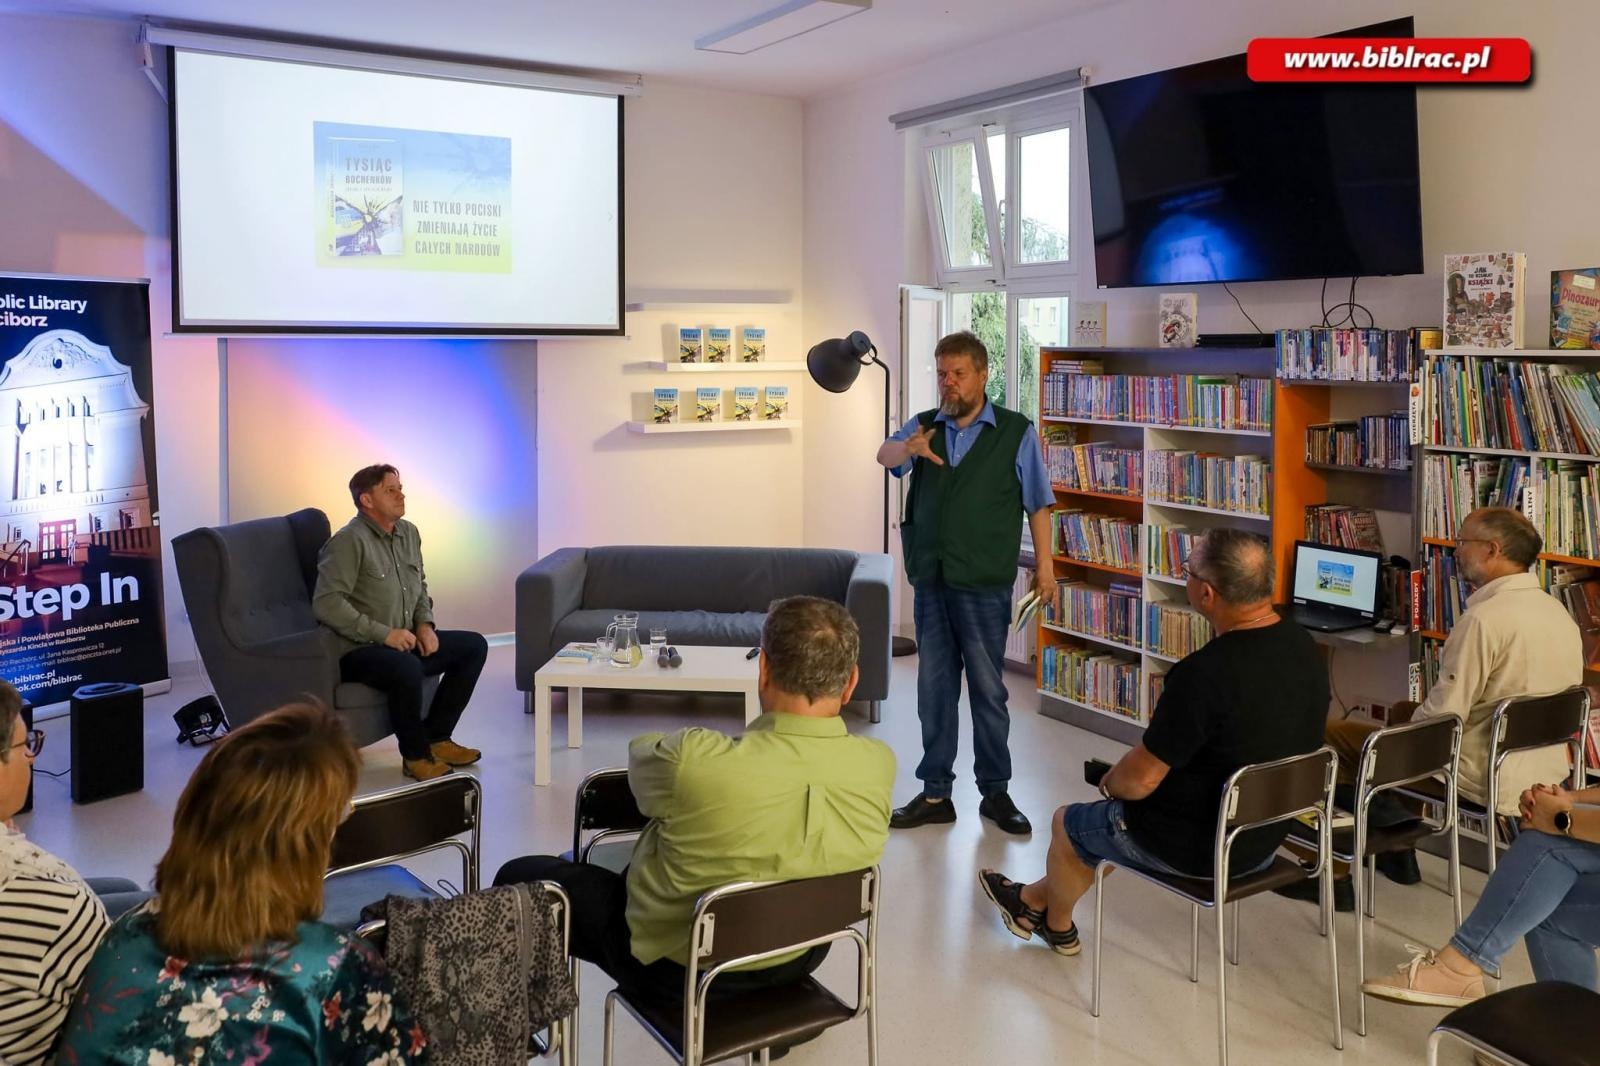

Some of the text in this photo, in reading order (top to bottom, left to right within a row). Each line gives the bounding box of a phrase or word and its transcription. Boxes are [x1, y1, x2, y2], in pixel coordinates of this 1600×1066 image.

[346, 158, 392, 173] TYSIĄC
[413, 200, 501, 217] NIE TYLKO POCISKI
[417, 221, 469, 237] ZMIENIAJĄ
[415, 240, 451, 255] CAŁYCH
[29, 295, 87, 314] Library
[100, 571, 139, 606] In
[21, 631, 65, 644] Powiatowa
[66, 624, 103, 636] Biblioteka
[104, 618, 139, 629] Publiczna
